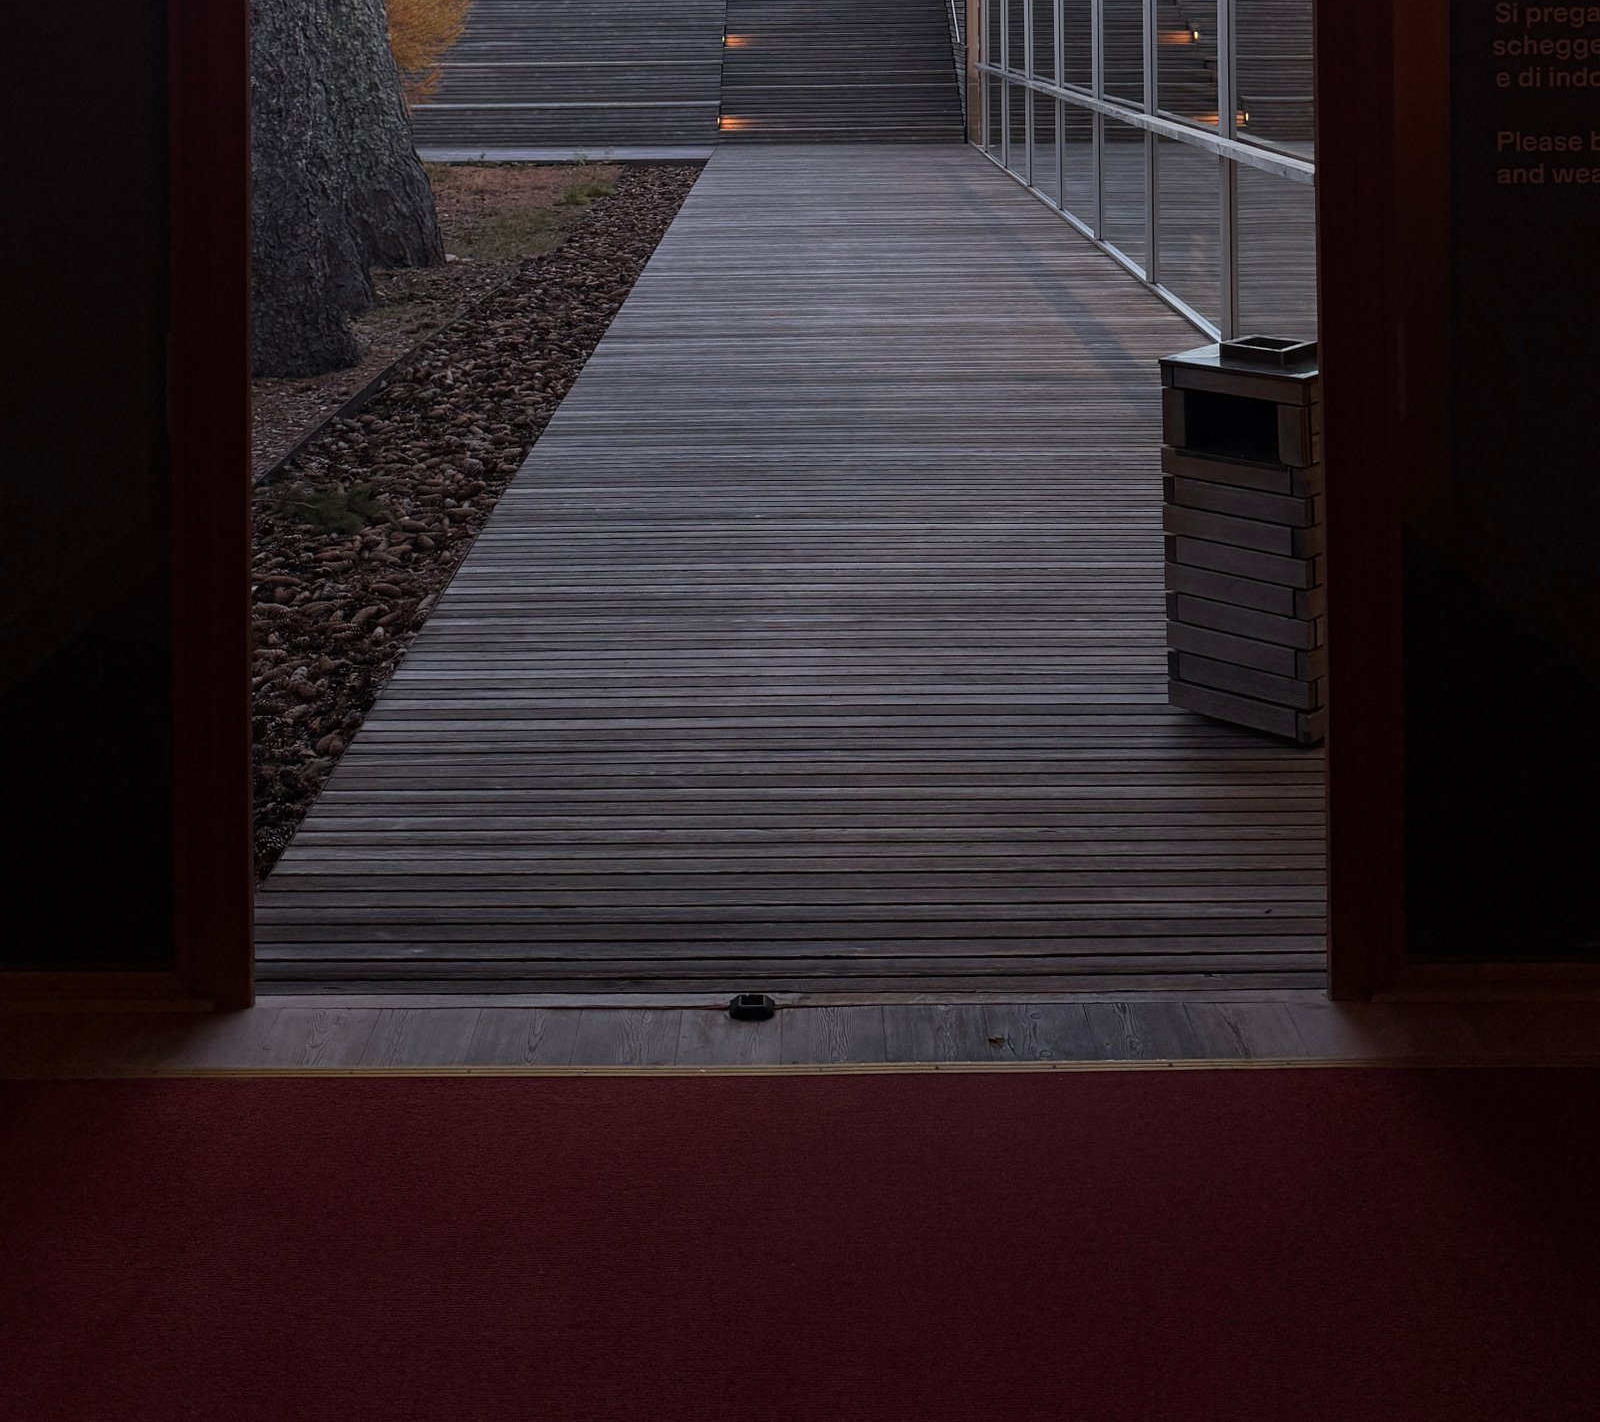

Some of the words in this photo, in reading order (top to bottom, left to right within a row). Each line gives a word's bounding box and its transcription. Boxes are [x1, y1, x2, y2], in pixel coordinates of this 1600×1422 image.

[1495, 2, 1518, 23] Si
[1526, 3, 1600, 28] prega
[1492, 34, 1600, 60] schegge
[1496, 71, 1510, 88] e
[1518, 66, 1540, 87] di
[1497, 131, 1583, 152] Please
[1497, 163, 1544, 184] and
